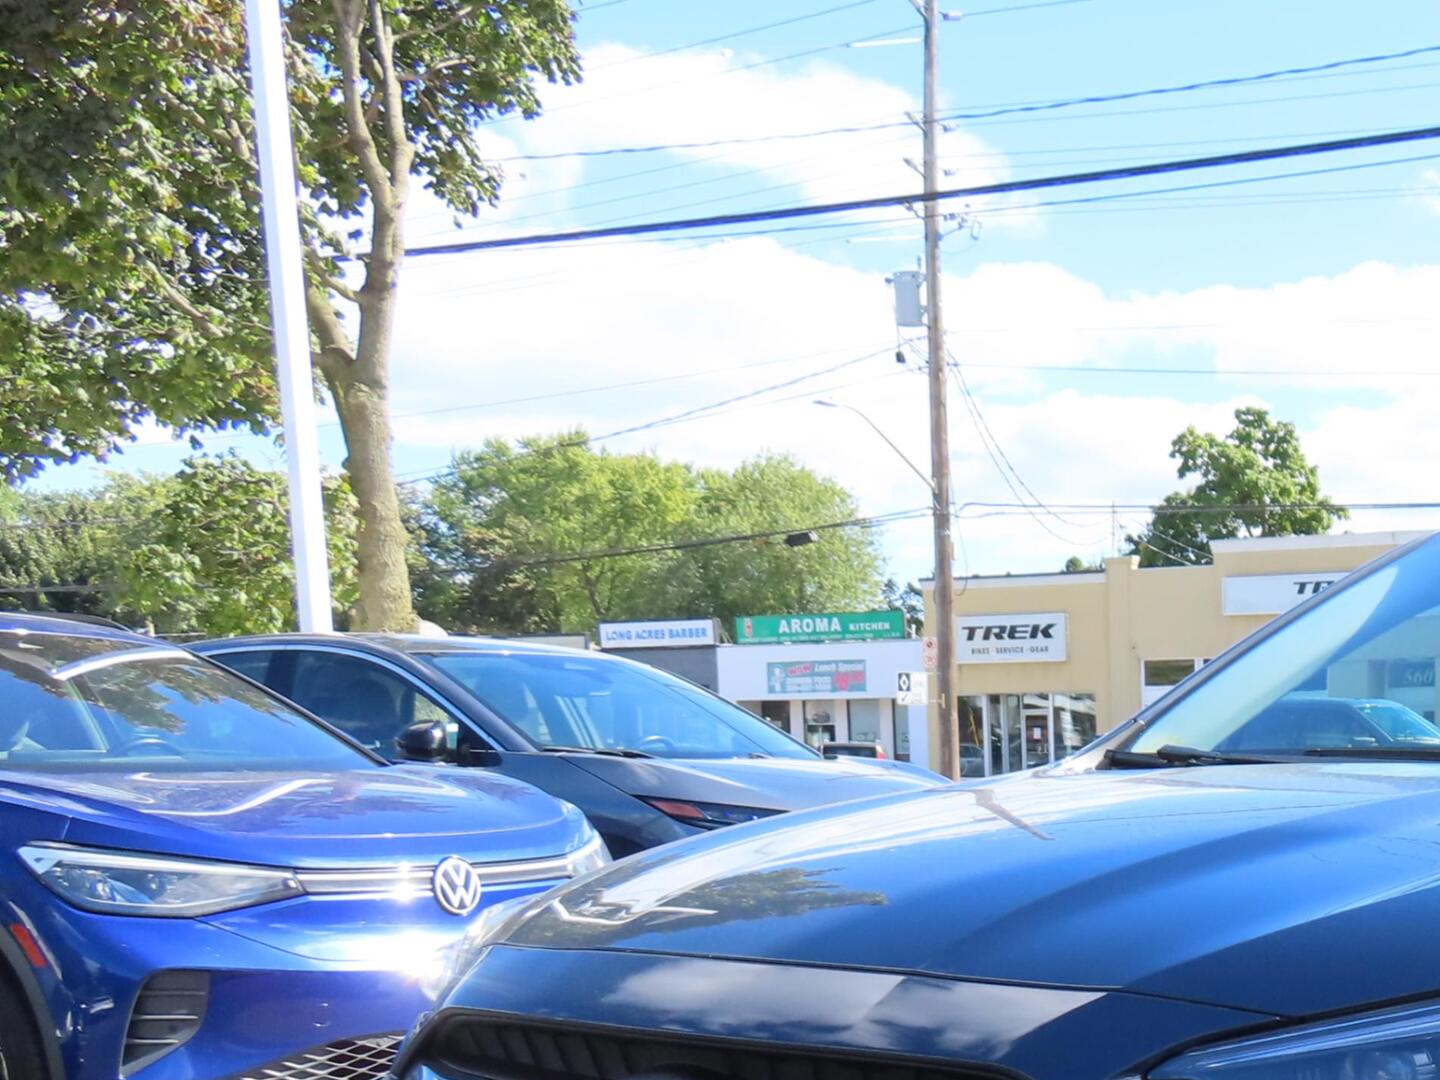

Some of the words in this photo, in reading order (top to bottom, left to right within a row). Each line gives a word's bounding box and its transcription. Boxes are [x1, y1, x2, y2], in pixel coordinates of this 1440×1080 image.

[1292, 580, 1335, 595] TR
[778, 616, 842, 634] AROMA
[848, 621, 890, 631] KITCHEN
[961, 623, 1057, 641] TREK
[605, 630, 632, 641] LONG
[635, 629, 665, 640] ACRES
[668, 627, 708, 639] BARBER
[971, 647, 990, 655] BIKES
[995, 646, 1024, 655] SERVICE
[1030, 645, 1049, 653] GEAR
